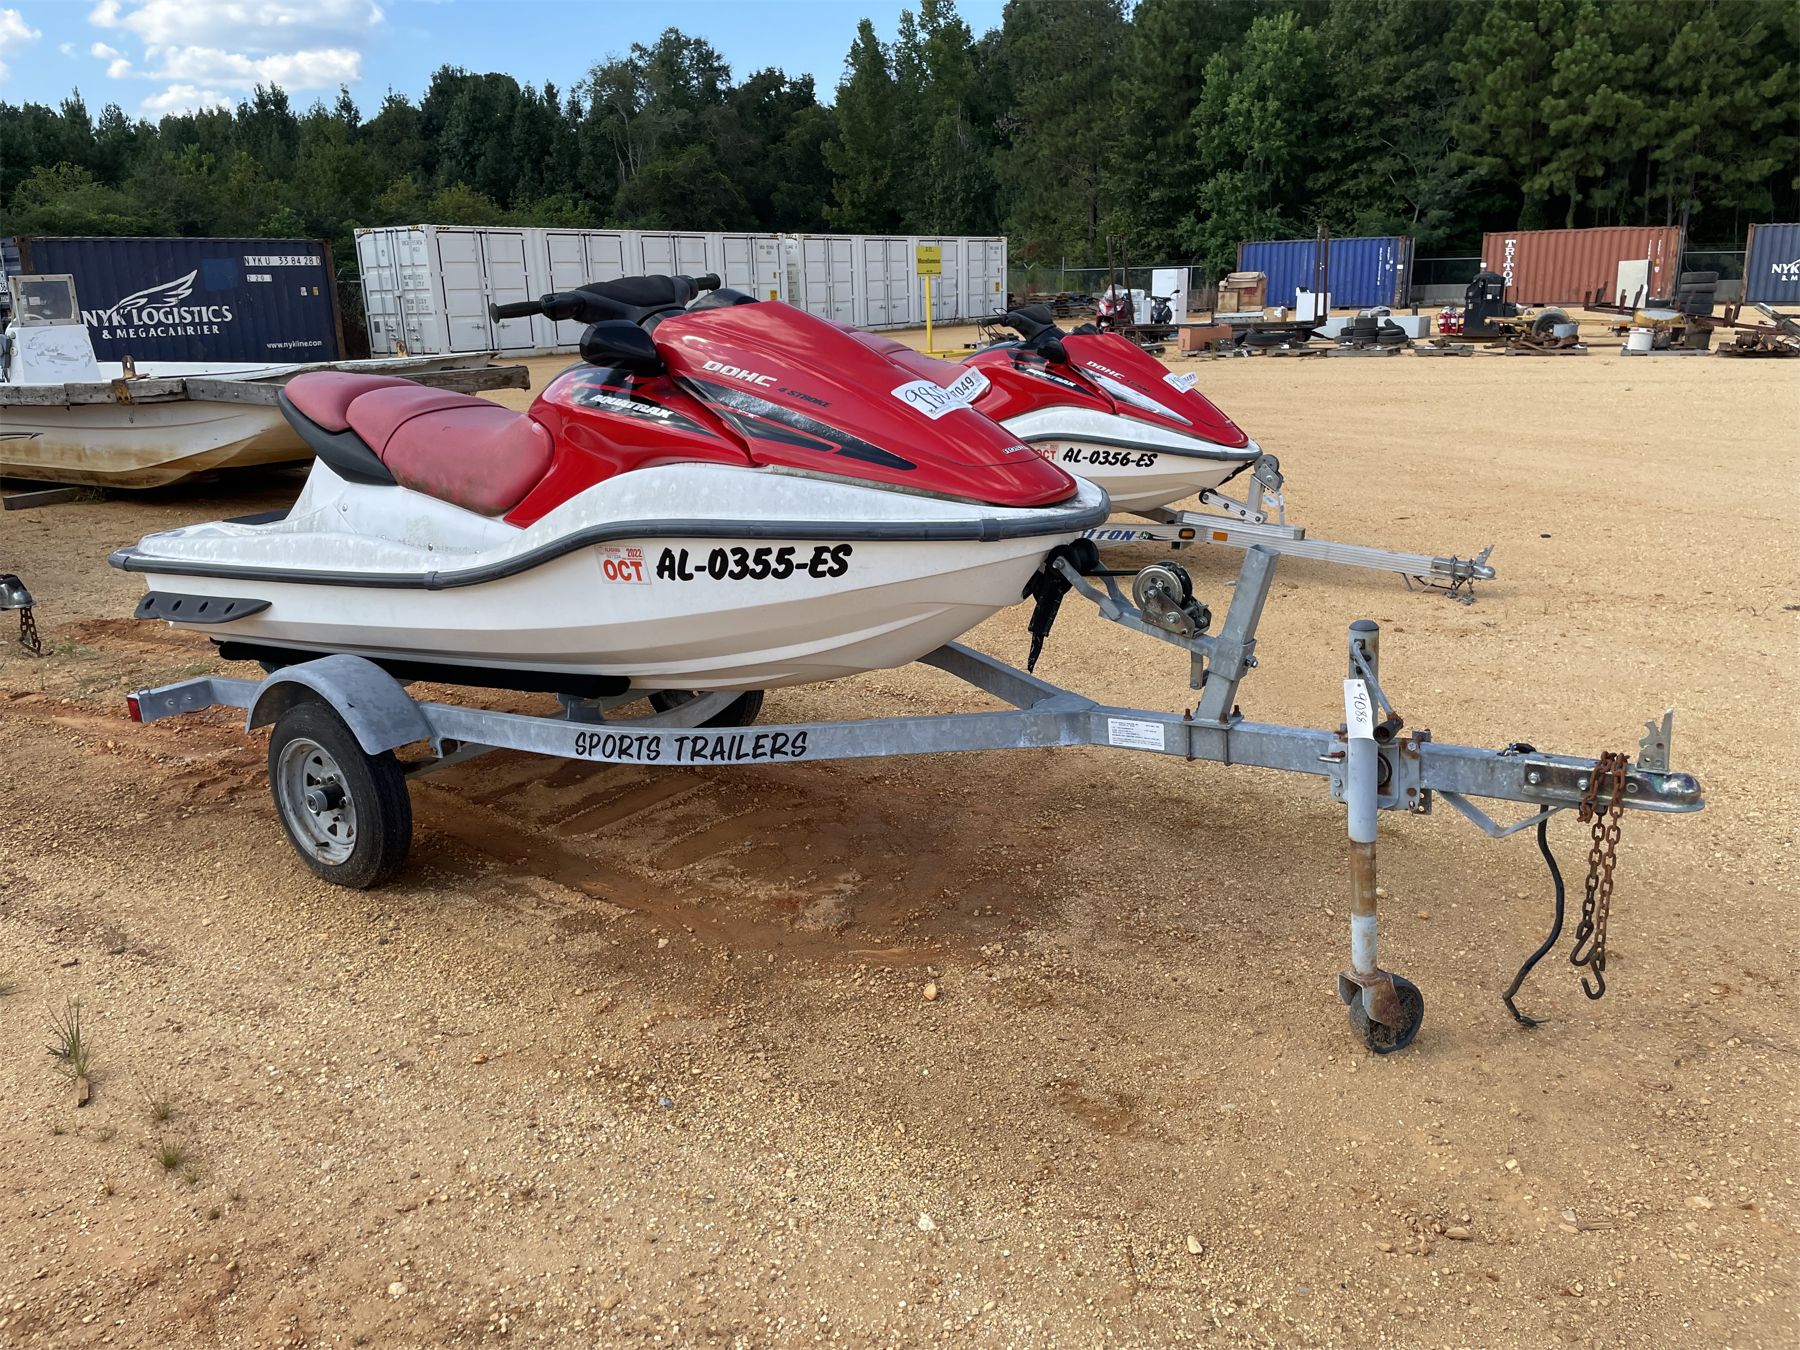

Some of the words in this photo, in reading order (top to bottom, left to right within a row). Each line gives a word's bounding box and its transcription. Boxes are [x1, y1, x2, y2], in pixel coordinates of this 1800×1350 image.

[244, 256, 271, 266] NYKU
[1503, 240, 1517, 287] TRITON
[1771, 263, 1800, 274] NYK
[81, 309, 128, 328] NYK
[131, 306, 233, 325] LOGISTICS
[102, 329, 113, 340] &
[116, 325, 220, 339] MEGACARRIER
[702, 360, 778, 388] DOHC
[1086, 360, 1126, 380] DOHC
[590, 394, 675, 419] AQUATRAX
[1062, 447, 1159, 468] AL-0356-ES
[625, 547, 643, 558] 2022
[656, 543, 853, 581] AL-0355-ES
[603, 559, 643, 582] OCT
[575, 731, 661, 761] SPORTS
[674, 731, 808, 762] TRAILERS
